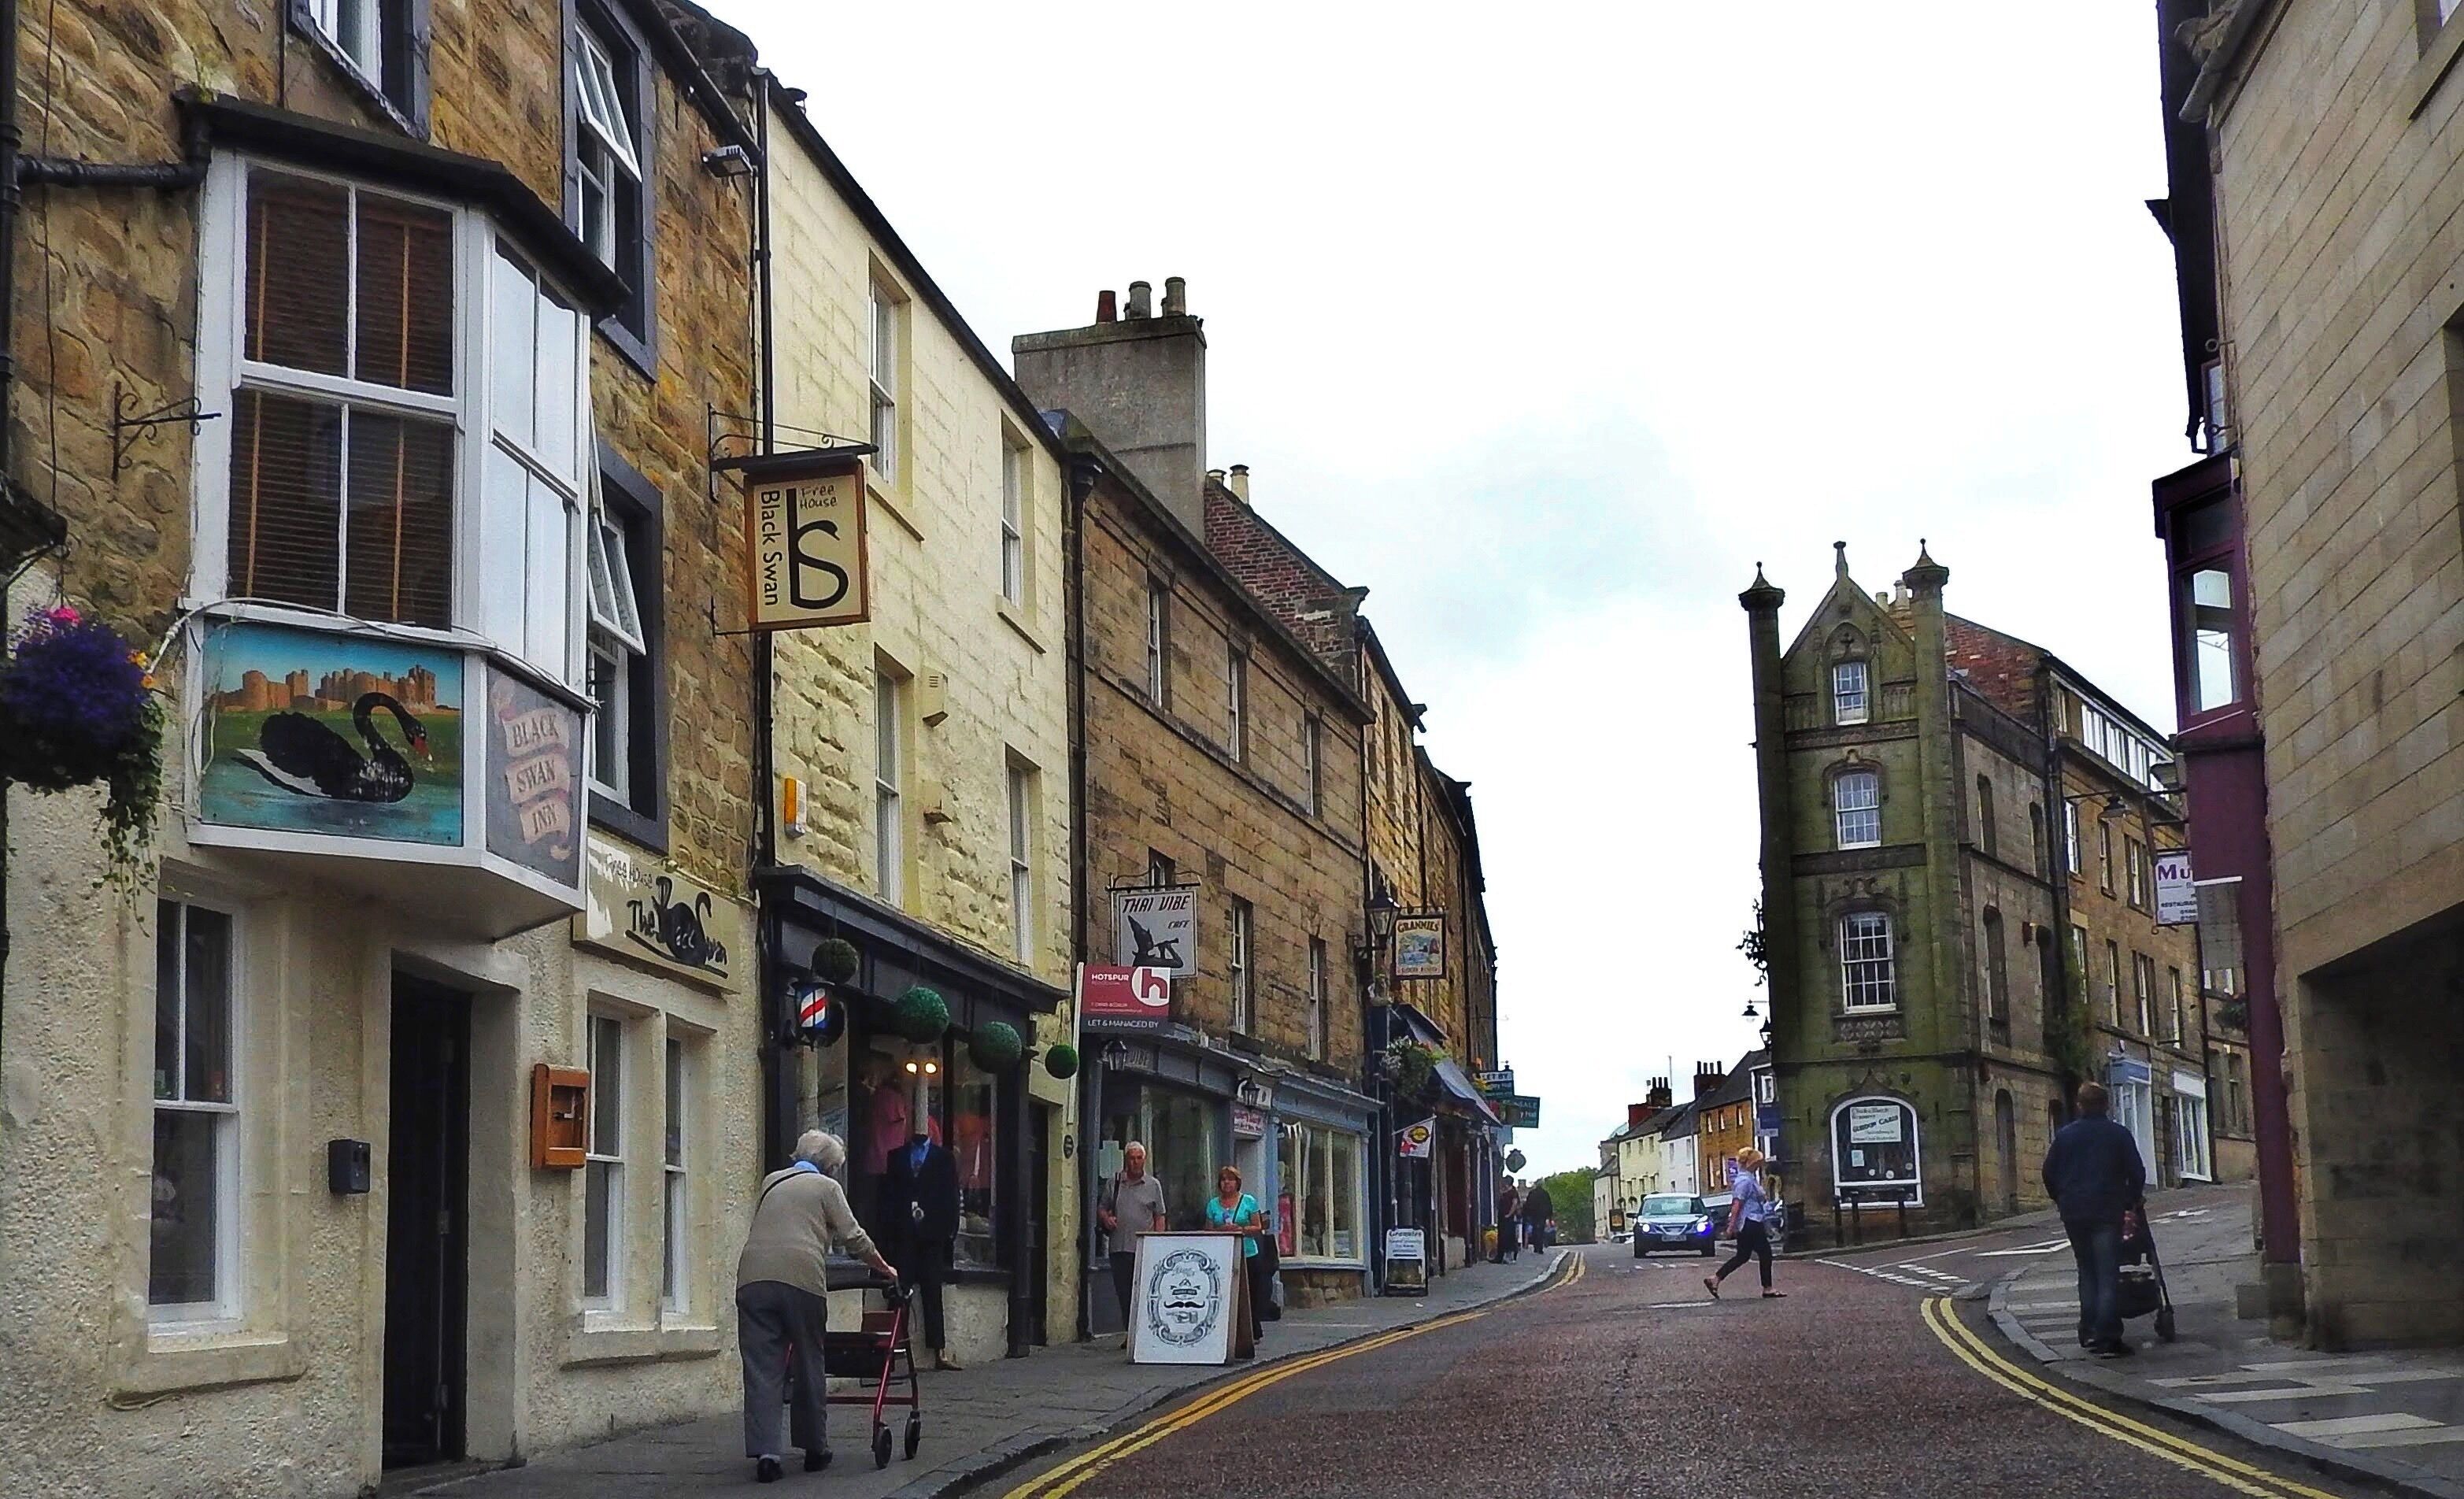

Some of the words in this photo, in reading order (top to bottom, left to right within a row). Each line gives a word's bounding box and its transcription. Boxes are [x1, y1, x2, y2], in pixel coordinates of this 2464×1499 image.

[799, 496, 838, 510] House
[801, 484, 834, 498] Free
[760, 490, 782, 546] Black
[762, 551, 783, 606] Swan
[512, 714, 559, 749] BLACK
[516, 759, 556, 793] SWAN
[531, 803, 557, 835] INN
[626, 899, 657, 938] The
[1123, 898, 1154, 913] THAI
[1158, 895, 1190, 911] VIBE
[1397, 920, 1439, 933] GRANNIES
